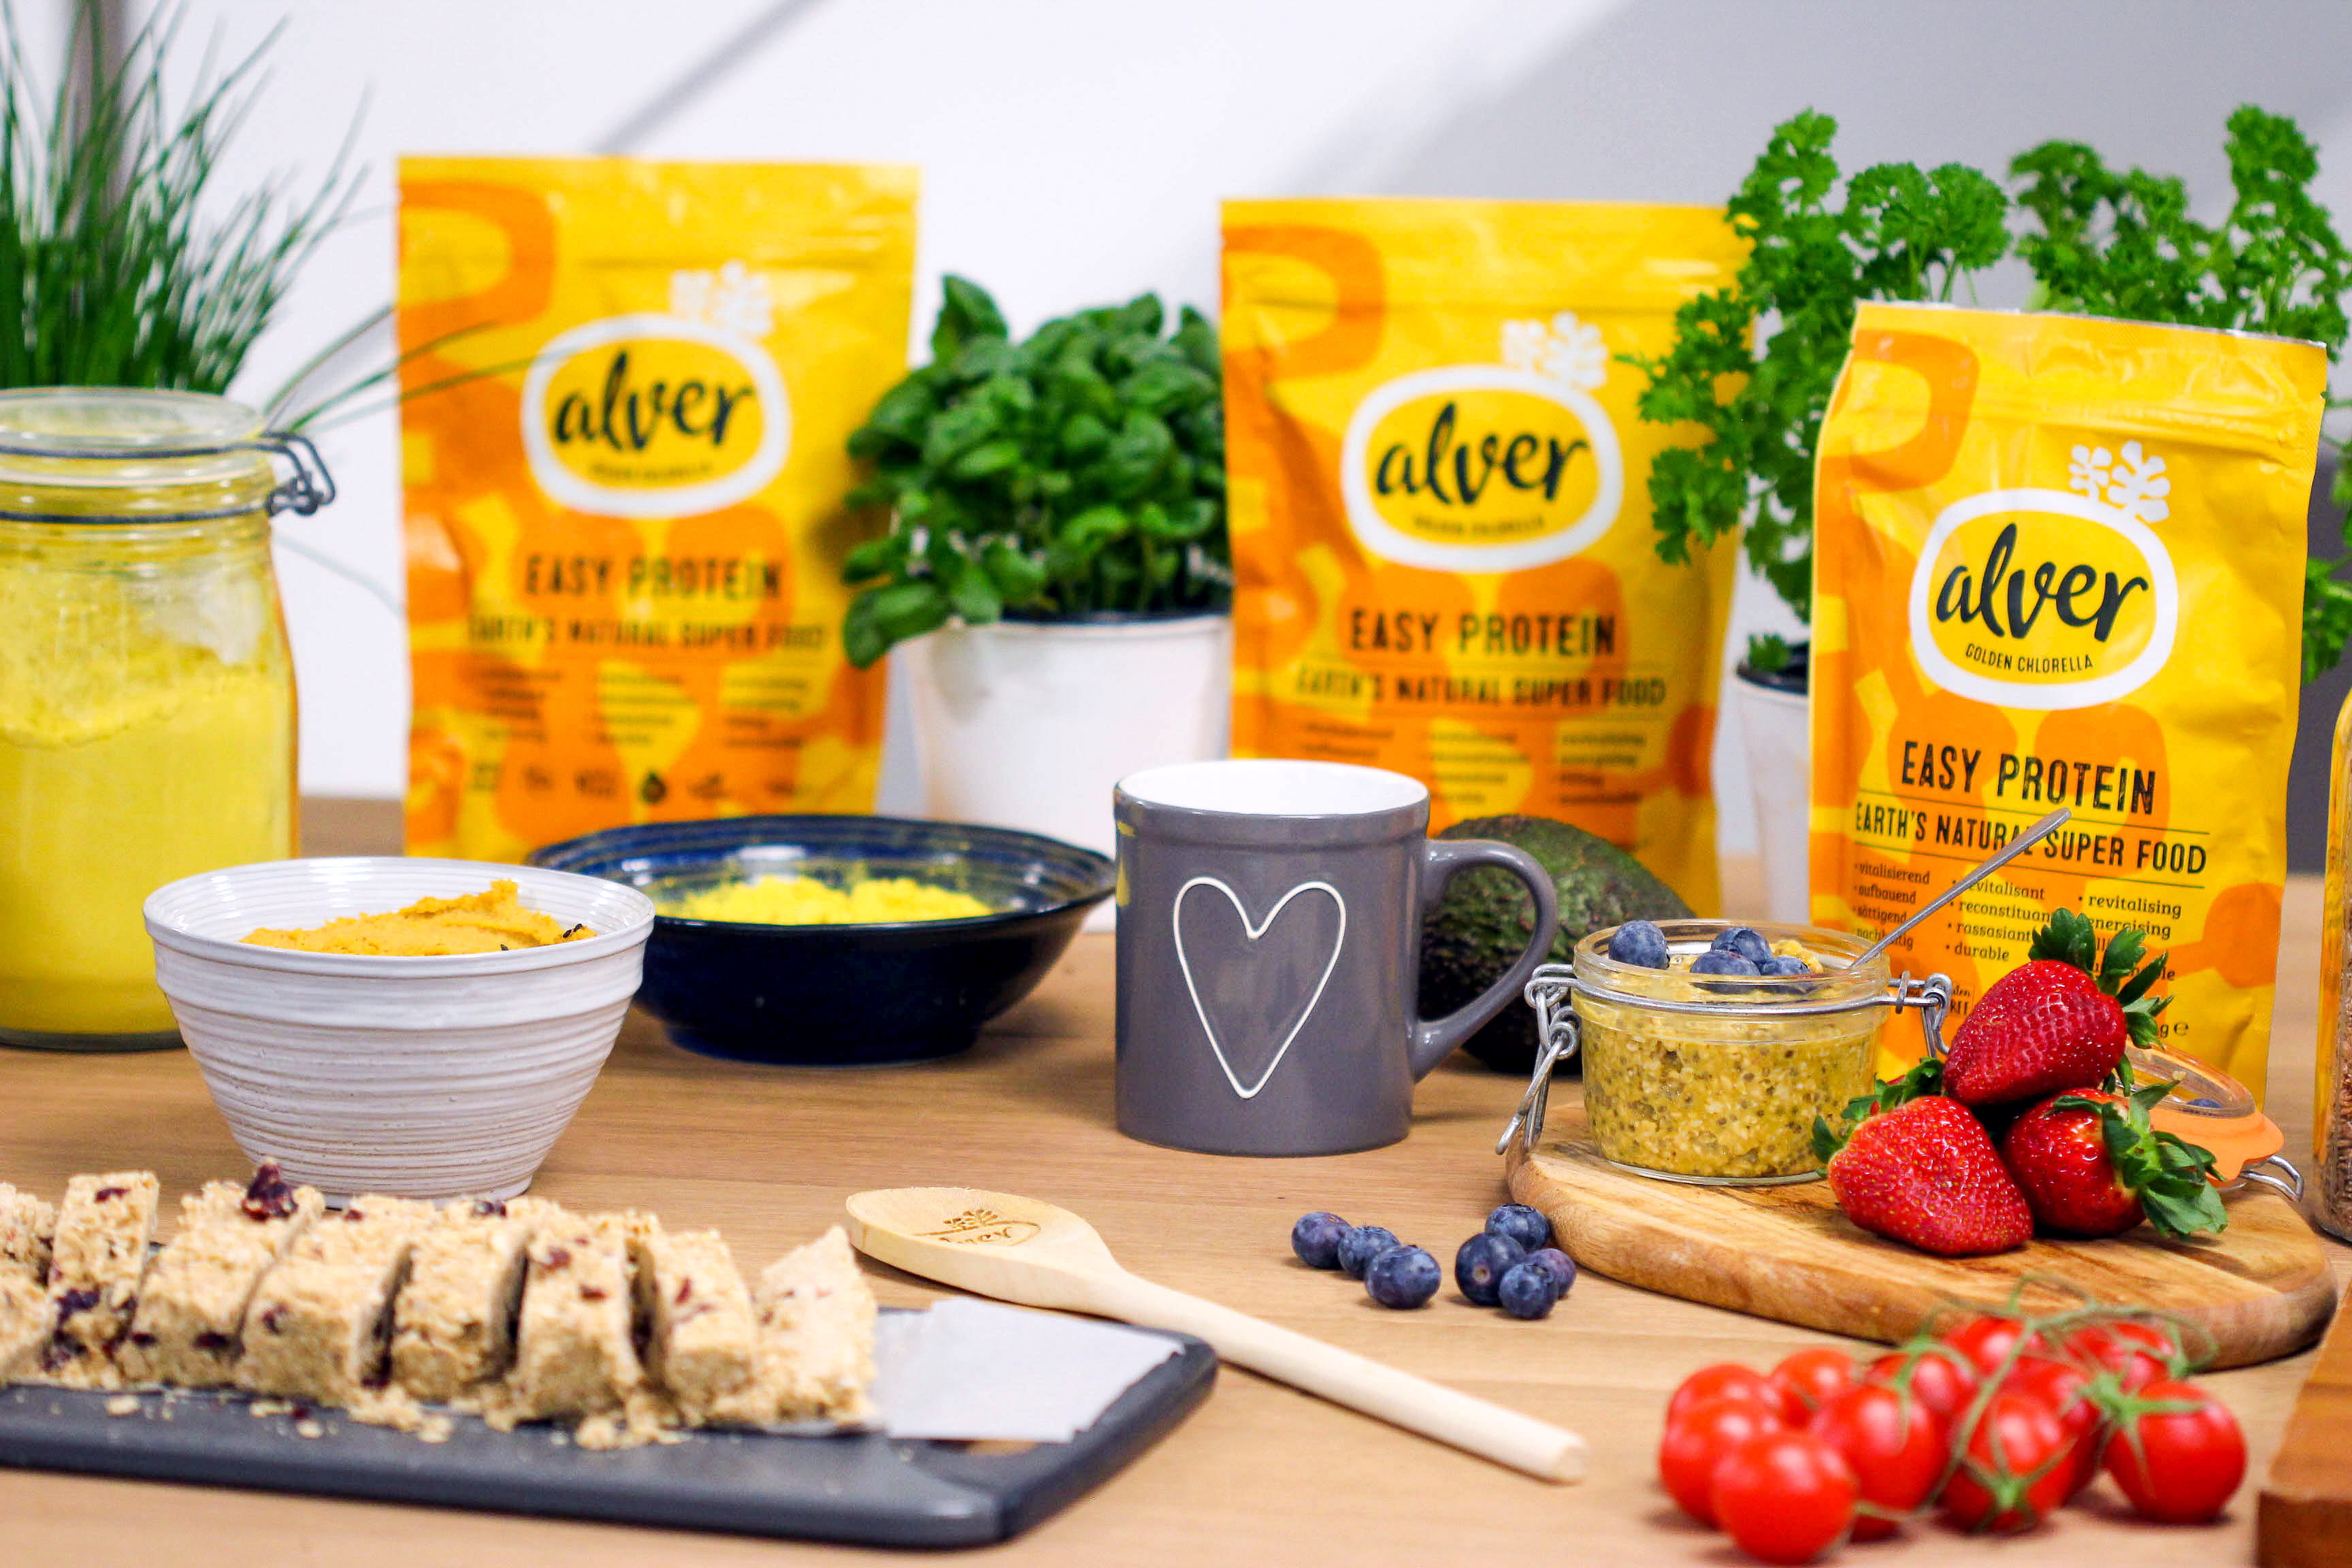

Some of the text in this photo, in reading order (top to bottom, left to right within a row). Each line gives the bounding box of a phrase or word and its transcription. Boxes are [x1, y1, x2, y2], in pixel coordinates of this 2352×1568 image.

[555, 350, 757, 452] alver
[1375, 402, 1590, 507] alver
[526, 555, 783, 602] EASY PROTEIN
[1935, 522, 2150, 643] alver
[1350, 608, 1617, 657] EASY PROTEIN
[1965, 642, 2094, 673] GOLDEN CHLORELLA
[1394, 676, 1501, 705] NATURAL
[1512, 677, 1592, 707] SUPER
[1602, 678, 1666, 707] FOOD
[1901, 740, 2156, 816] EASY PROTEIN
[1856, 802, 1927, 842] EARTH'S
[2044, 829, 2125, 867] SUPER
[2136, 840, 2207, 875] FOOD
[1859, 862, 1930, 885] vitalisierend
[1859, 884, 1916, 904] aufbauend
[1968, 879, 2046, 900] vitalisant
[1959, 900, 2051, 923] reconstituan
[2089, 895, 2182, 919] revitalising
[1956, 923, 2032, 943] rassasiant
[1955, 941, 2009, 962] durable
